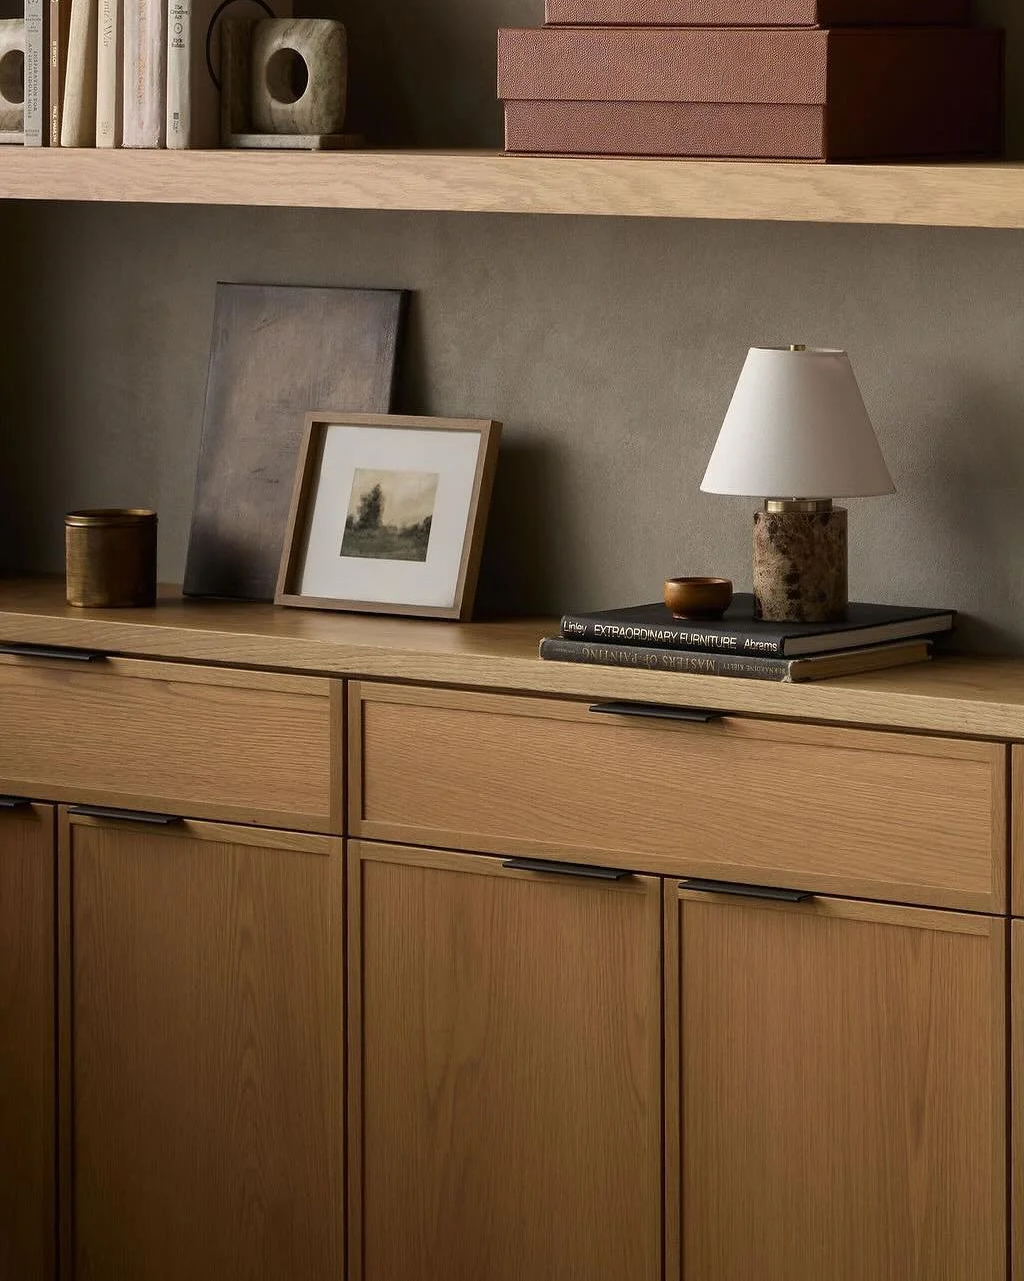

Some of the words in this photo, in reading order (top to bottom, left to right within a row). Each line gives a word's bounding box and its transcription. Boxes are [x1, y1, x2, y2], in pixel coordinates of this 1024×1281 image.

[563, 620, 588, 636] Linley
[594, 624, 679, 643] EXTRAORDINARY
[680, 632, 737, 649] FURNITURE
[744, 638, 778, 652] Abrams
[581, 647, 638, 662] PAINTING
[643, 654, 658, 665] OF
[662, 655, 715, 671] MASTERS
